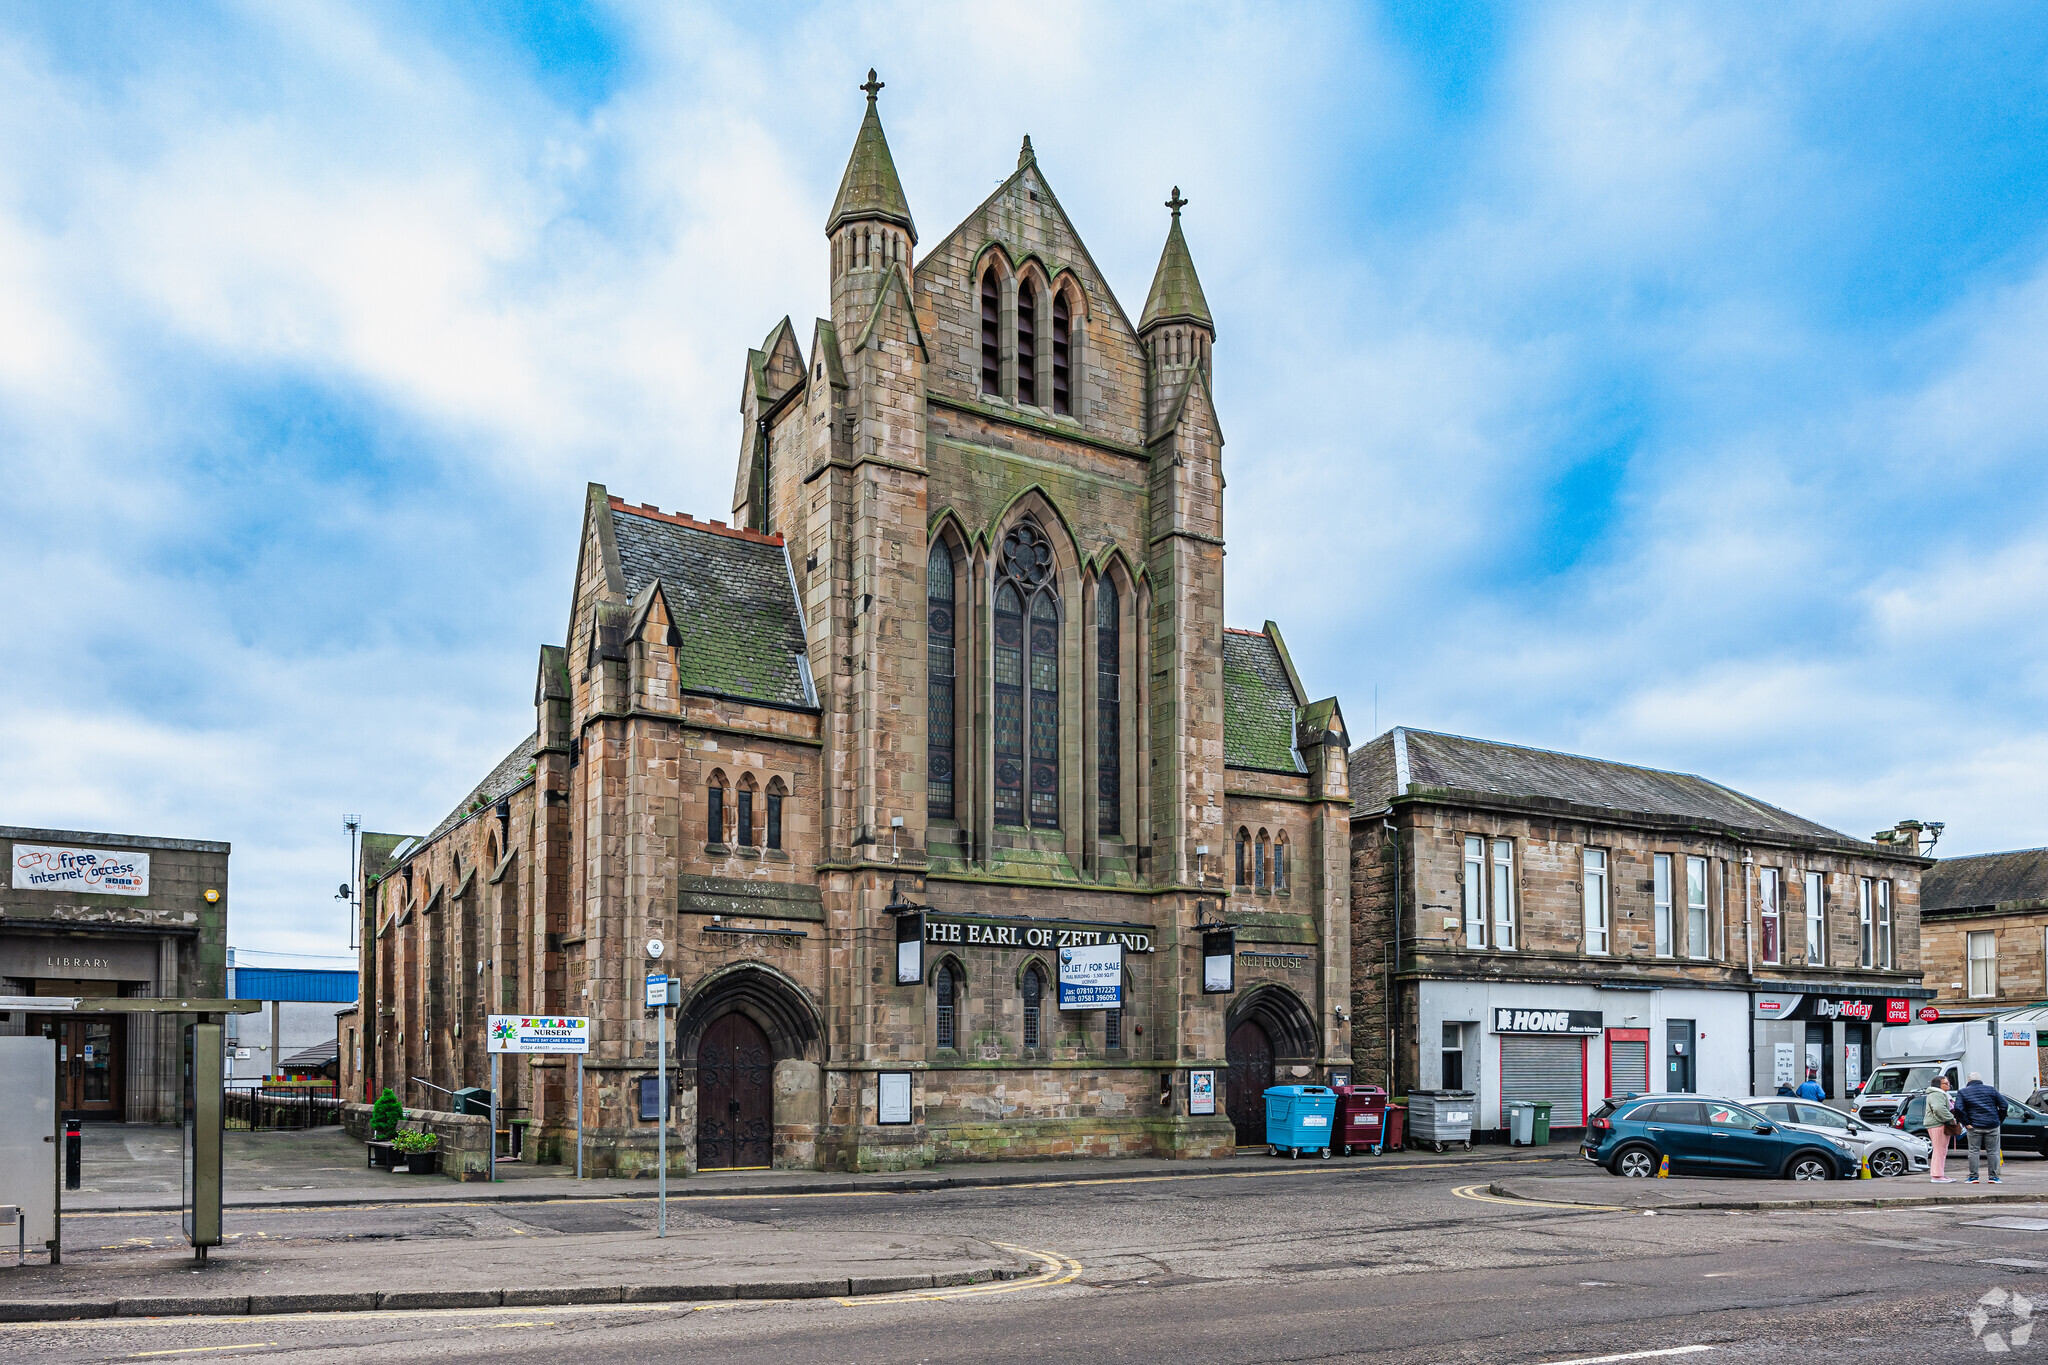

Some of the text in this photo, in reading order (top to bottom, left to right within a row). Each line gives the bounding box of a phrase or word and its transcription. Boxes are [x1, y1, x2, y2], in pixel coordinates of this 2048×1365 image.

[60, 853, 97, 868] free
[29, 863, 134, 884] internet access
[117, 884, 141, 892] Library
[698, 931, 803, 949] FREE HOUSE
[967, 924, 1022, 945] EARL
[1025, 928, 1053, 947] OF
[1056, 930, 1149, 951] ZETLAND
[48, 957, 109, 968] LIBRARY
[1061, 962, 1120, 973] TO LET / FOR SALE
[1263, 955, 1302, 969] HOUSE
[1076, 987, 1094, 995] 07810
[1094, 986, 1116, 994] 717229
[1891, 1001, 1905, 1009] POST
[1889, 1011, 1907, 1019] OFFICE
[521, 1018, 585, 1028] ZETLAND
[1512, 1011, 1569, 1031] HONG
